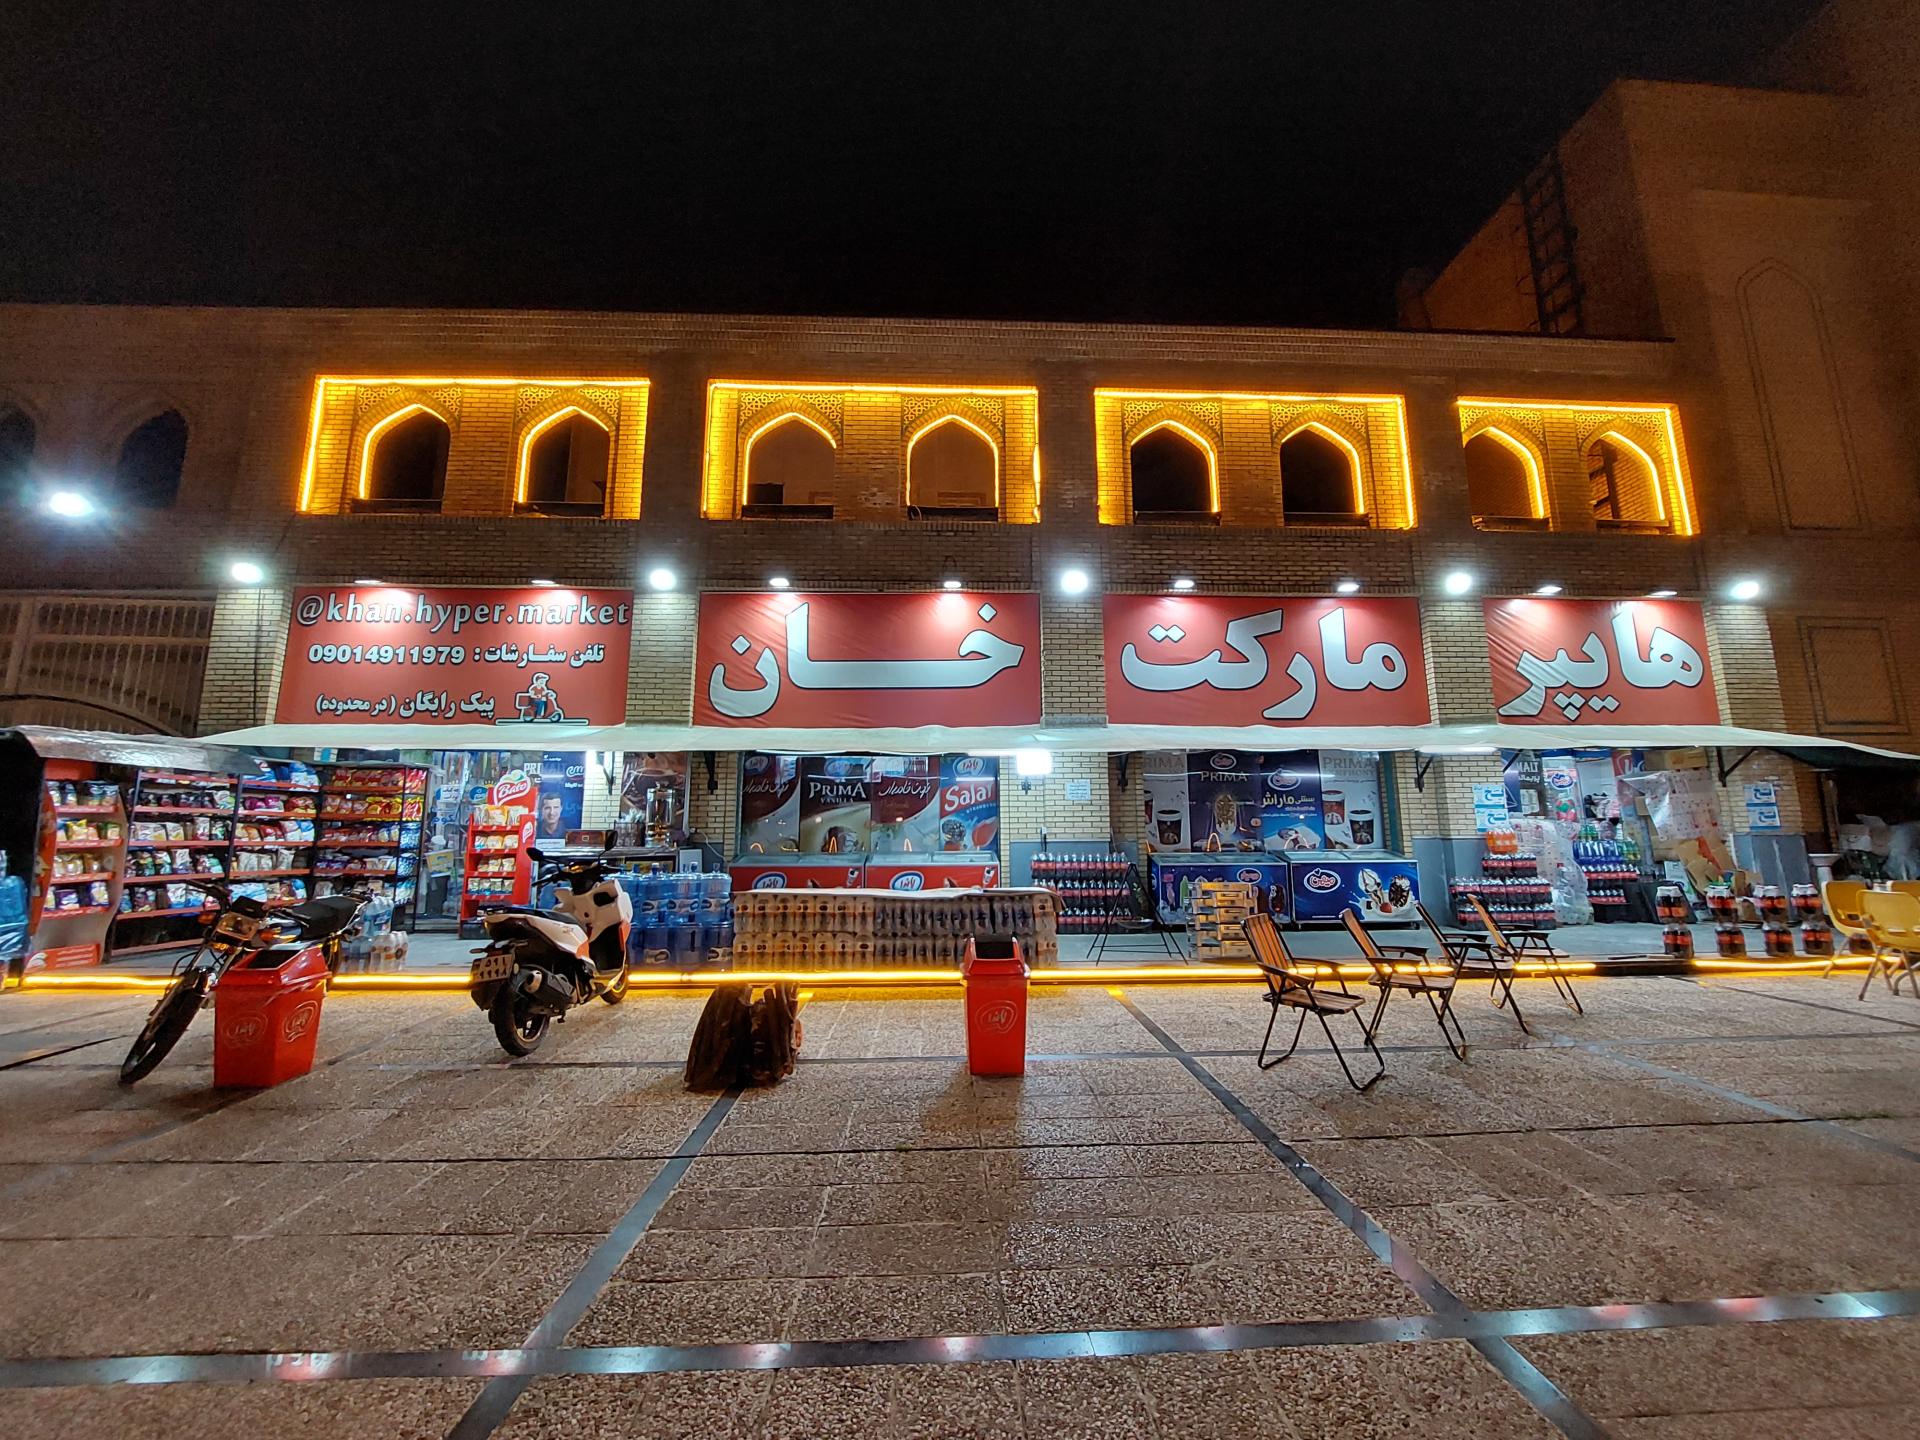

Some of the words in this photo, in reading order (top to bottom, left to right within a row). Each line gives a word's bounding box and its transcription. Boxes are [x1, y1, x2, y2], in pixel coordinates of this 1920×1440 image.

[296, 592, 630, 633] @khan.hyper.market
[308, 643, 466, 665] 09014911979
[569, 642, 606, 667] تلفن
[708, 601, 1026, 719] خان
[1120, 606, 1408, 721] مارکت
[1496, 601, 1705, 722] هایپر
[399, 690, 457, 719] رایگان
[460, 690, 496, 719] پیک
[808, 781, 867, 799] PRIMA
